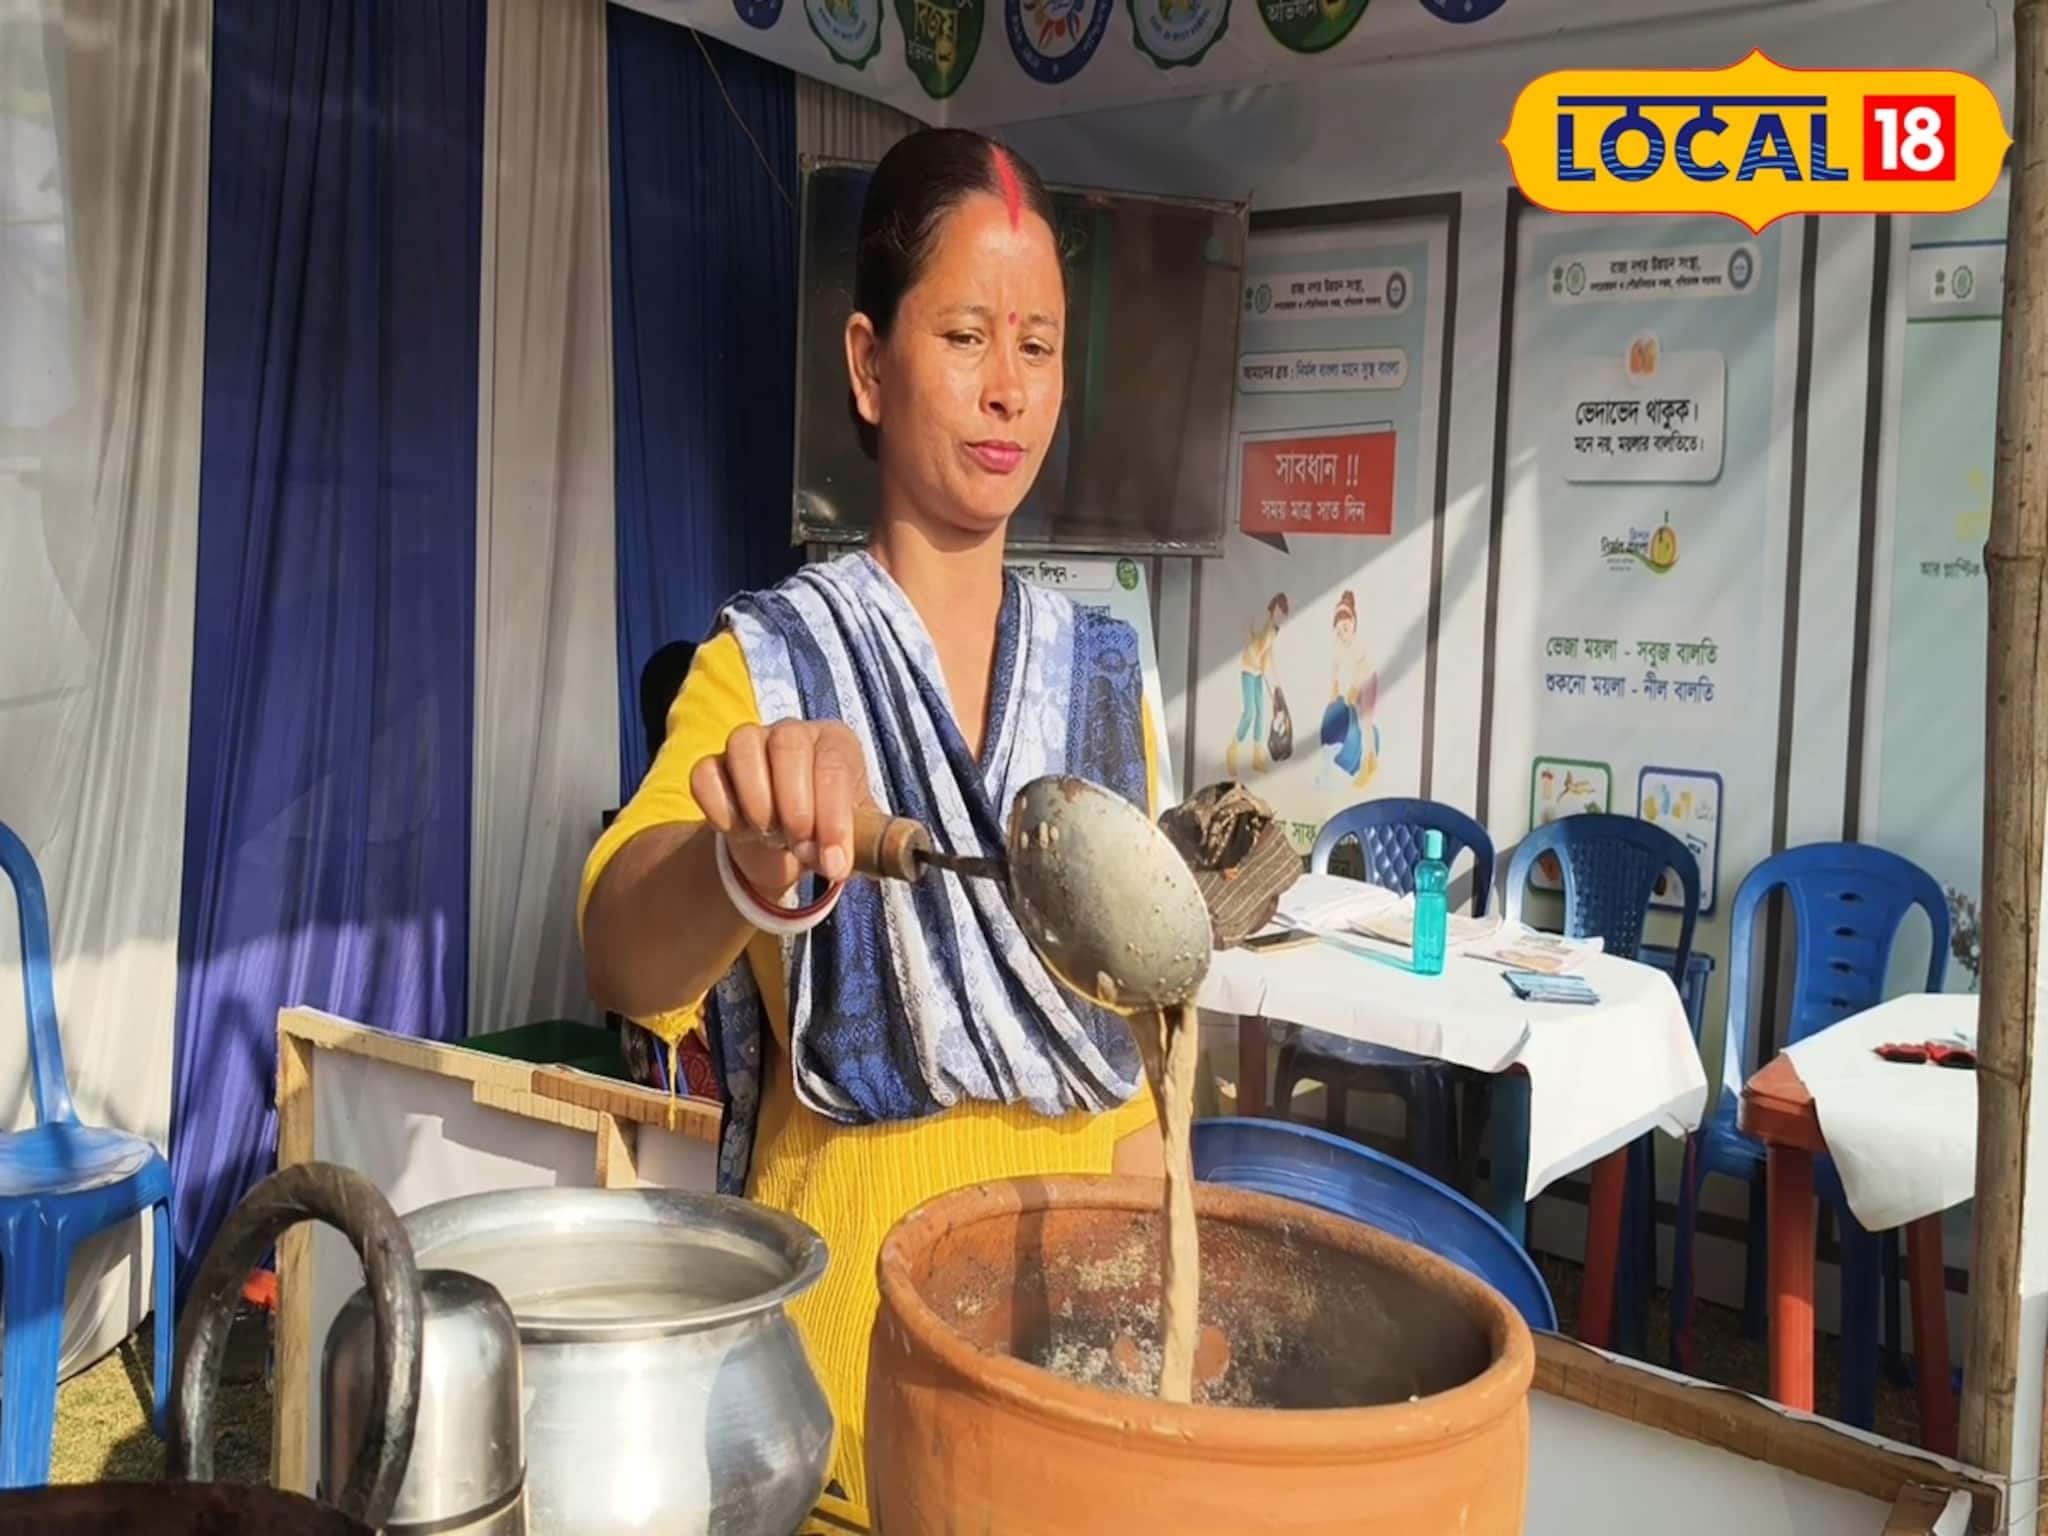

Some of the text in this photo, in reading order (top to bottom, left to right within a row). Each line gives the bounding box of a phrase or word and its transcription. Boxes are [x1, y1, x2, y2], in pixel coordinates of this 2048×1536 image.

[1575, 400, 1641, 426] ভেদাভেদ
[1275, 453, 1338, 486] সাবধান
[1344, 494, 1366, 522] দিন
[1039, 561, 1068, 584] লিখুন
[1546, 636, 1580, 659] ভেজা
[1584, 638, 1618, 661] ময়লা
[1637, 640, 1672, 668] সবুজ
[1676, 637, 1718, 665] বালতি
[1591, 675, 1627, 698] ময়লা
[1643, 670, 1669, 700] নীল
[1674, 675, 1716, 702] বালতি
